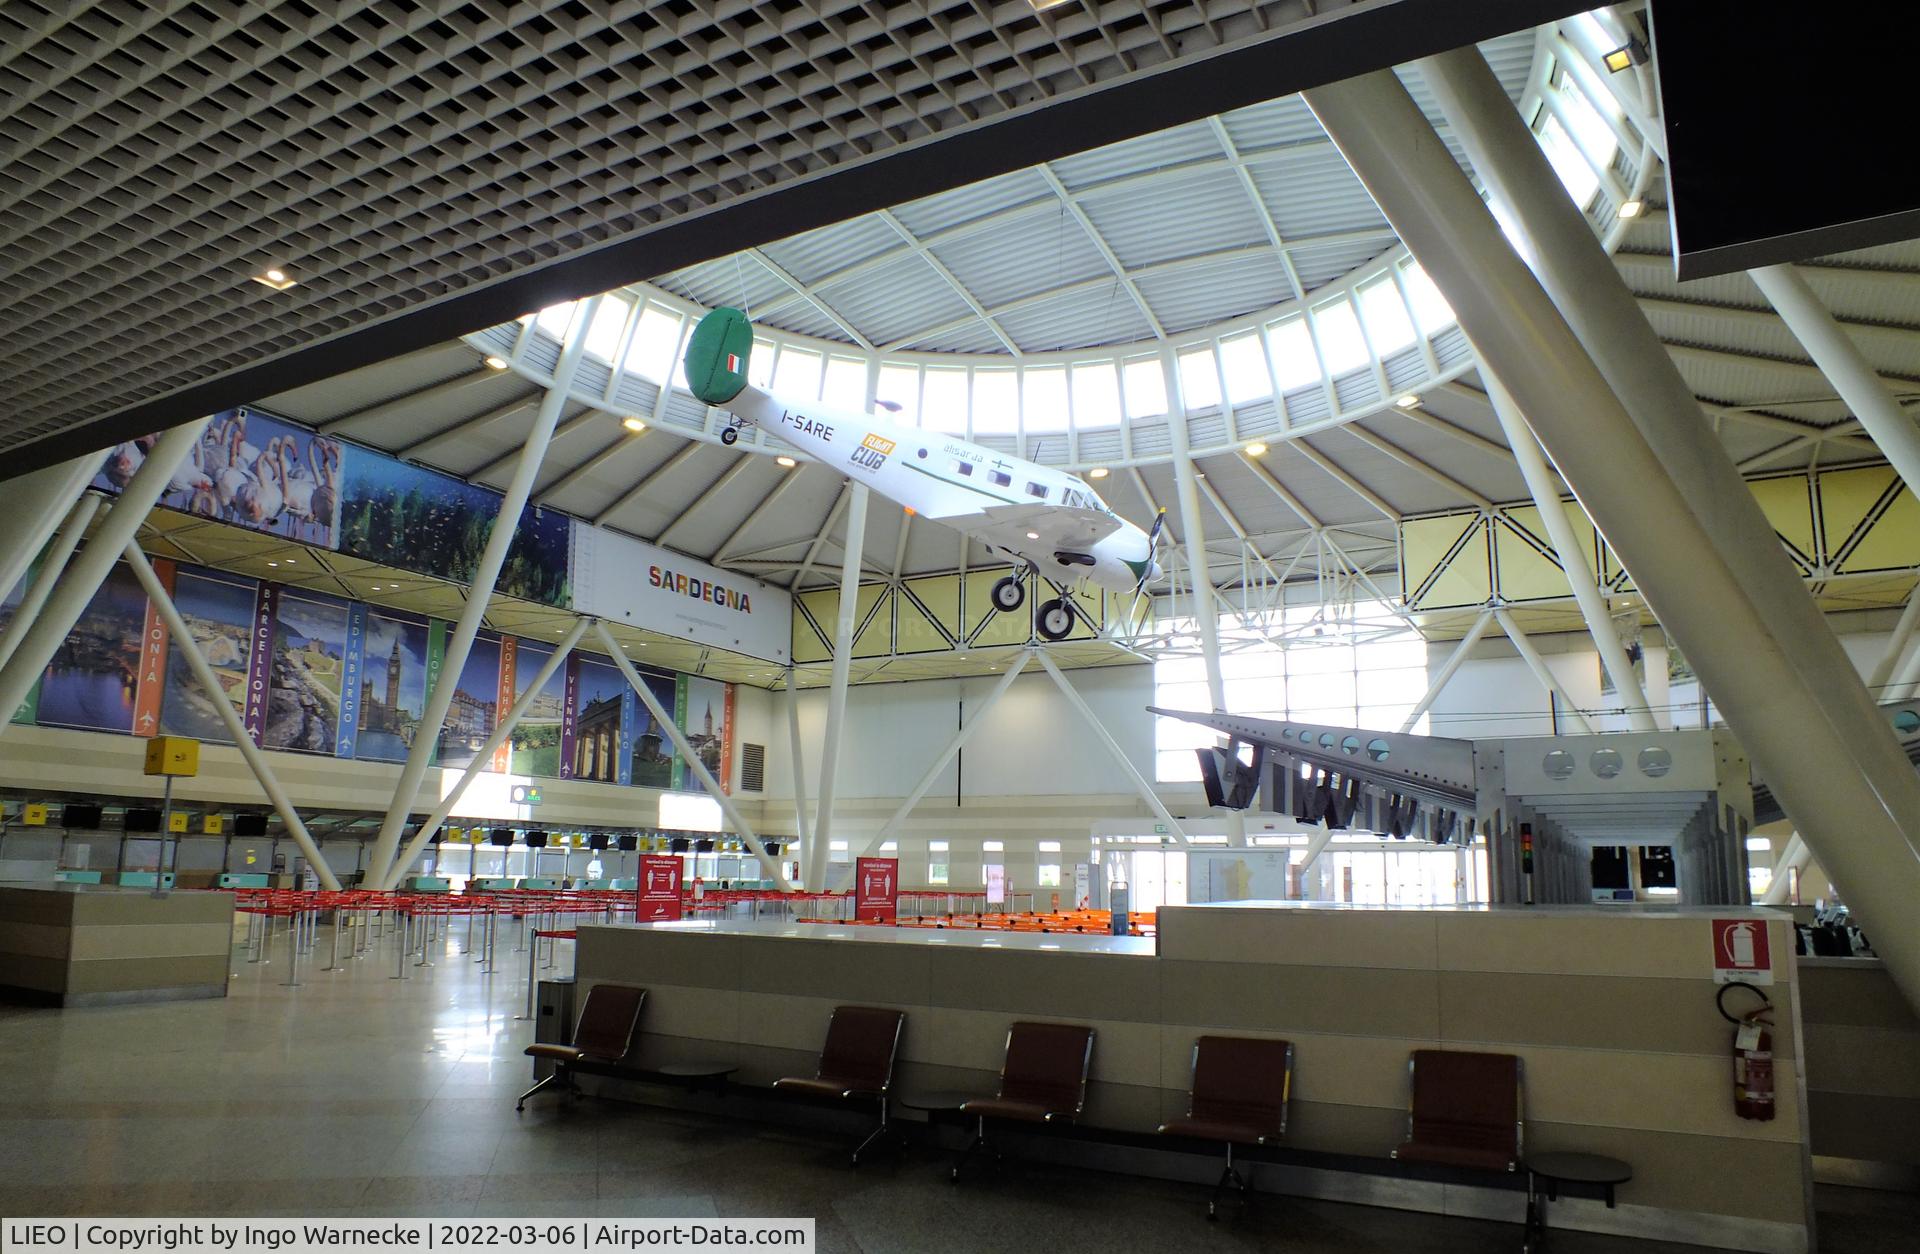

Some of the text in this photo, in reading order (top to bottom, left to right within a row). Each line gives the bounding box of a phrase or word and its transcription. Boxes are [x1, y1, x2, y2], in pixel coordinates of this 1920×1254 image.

[781, 409, 835, 442] I-SARE
[865, 435, 894, 453] FLIGHT
[850, 445, 887, 470] CLUB
[649, 565, 752, 614] SARDEGNA
[146, 614, 165, 682] LONIA
[250, 588, 271, 718] BARCELLONA
[343, 614, 361, 723] EDIMBURGO
[565, 676, 576, 737] VIENNA
